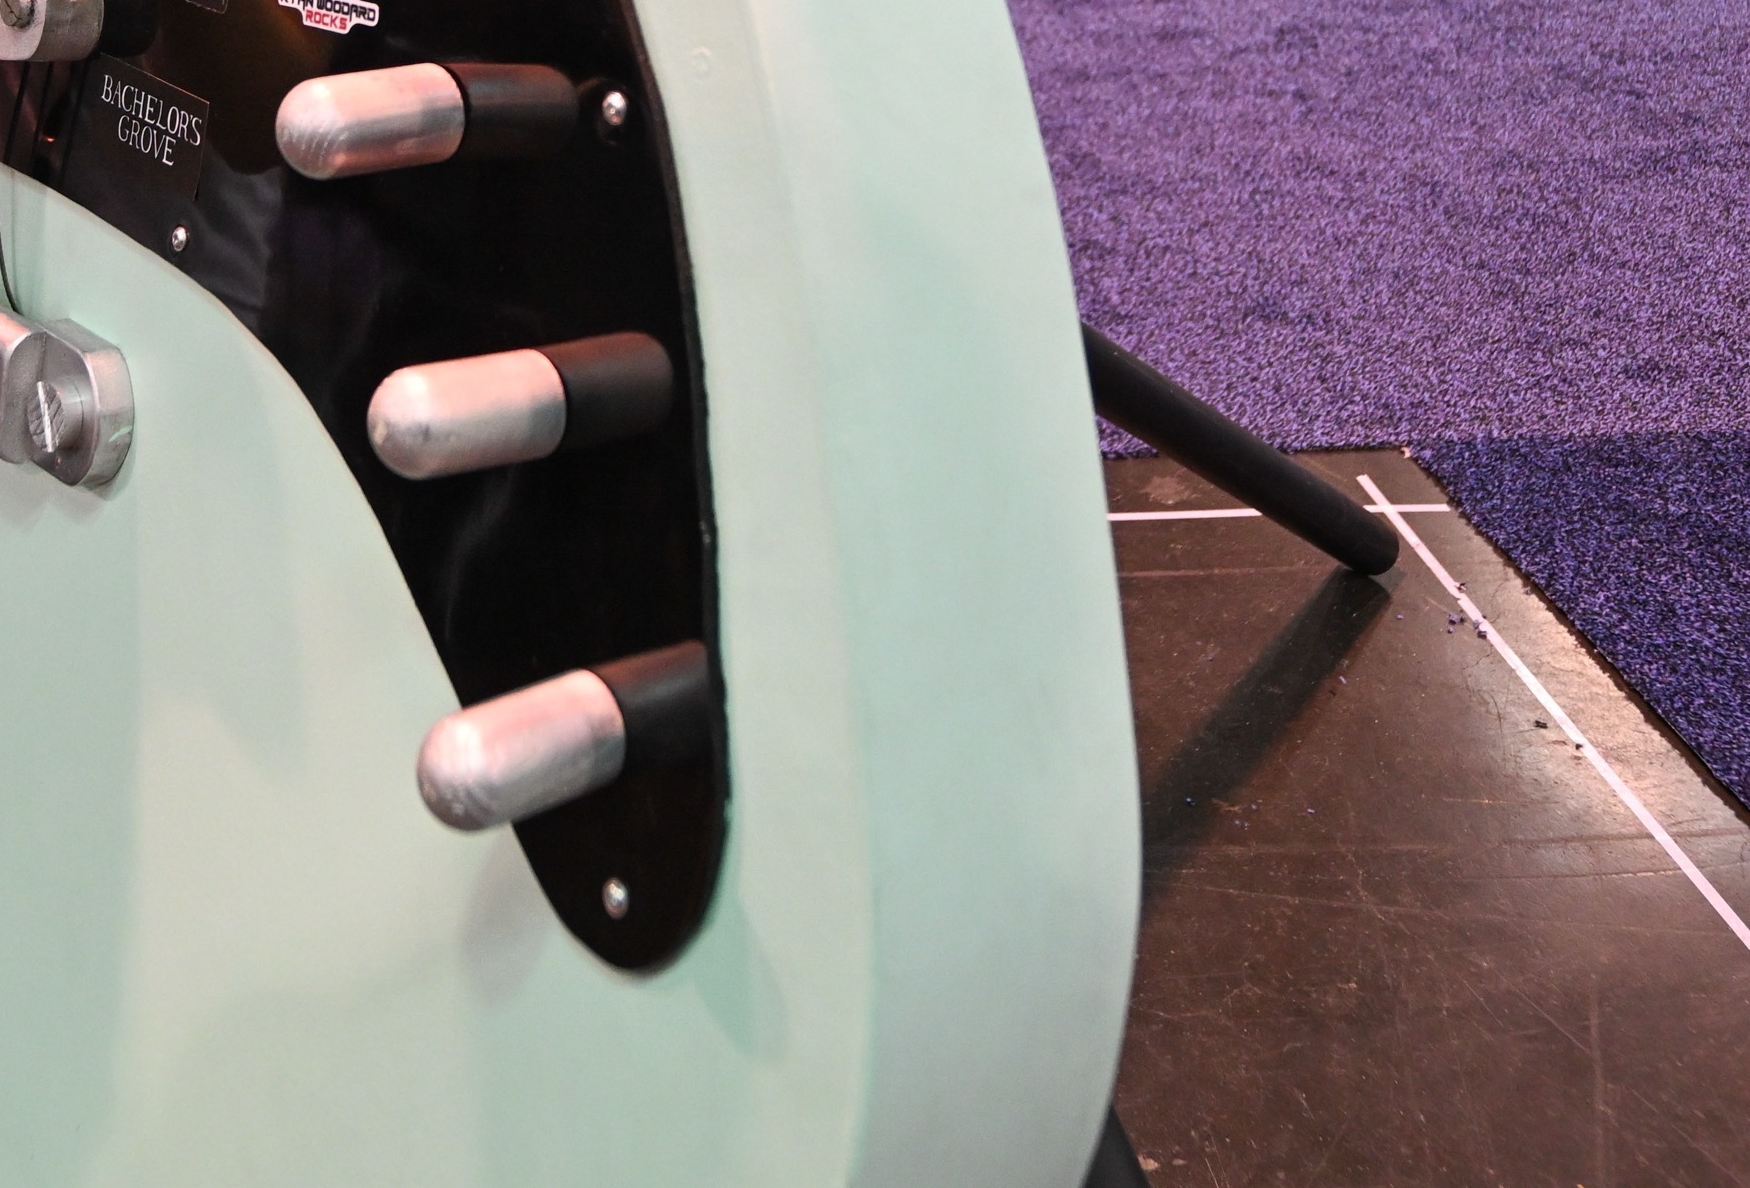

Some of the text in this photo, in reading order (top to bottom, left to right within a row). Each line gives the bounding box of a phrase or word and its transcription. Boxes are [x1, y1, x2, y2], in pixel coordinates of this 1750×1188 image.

[306, 9, 348, 30] ROCKS
[101, 74, 202, 146] BACHELOR'S
[118, 115, 176, 166] GROVE
